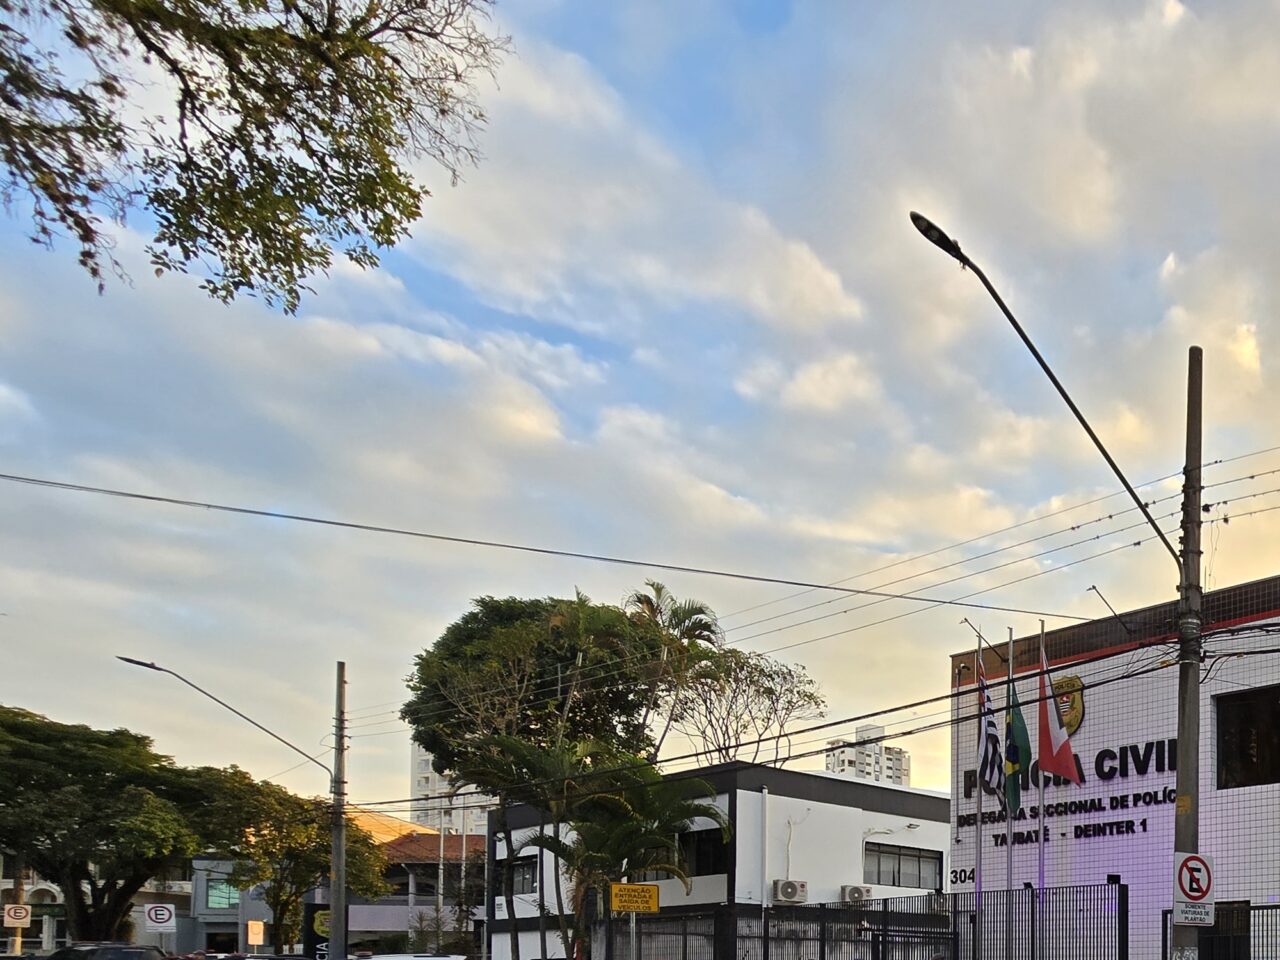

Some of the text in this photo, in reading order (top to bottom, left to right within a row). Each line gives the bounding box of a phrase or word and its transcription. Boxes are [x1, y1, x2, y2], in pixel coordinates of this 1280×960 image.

[1110, 795, 1129, 811] DE
[1133, 786, 1177, 807] POLÍC
[1074, 820, 1135, 839] DEINTER
[1140, 818, 1148, 833] 1
[950, 868, 975, 885] 304
[13, 908, 23, 918] E
[154, 909, 165, 921] E
